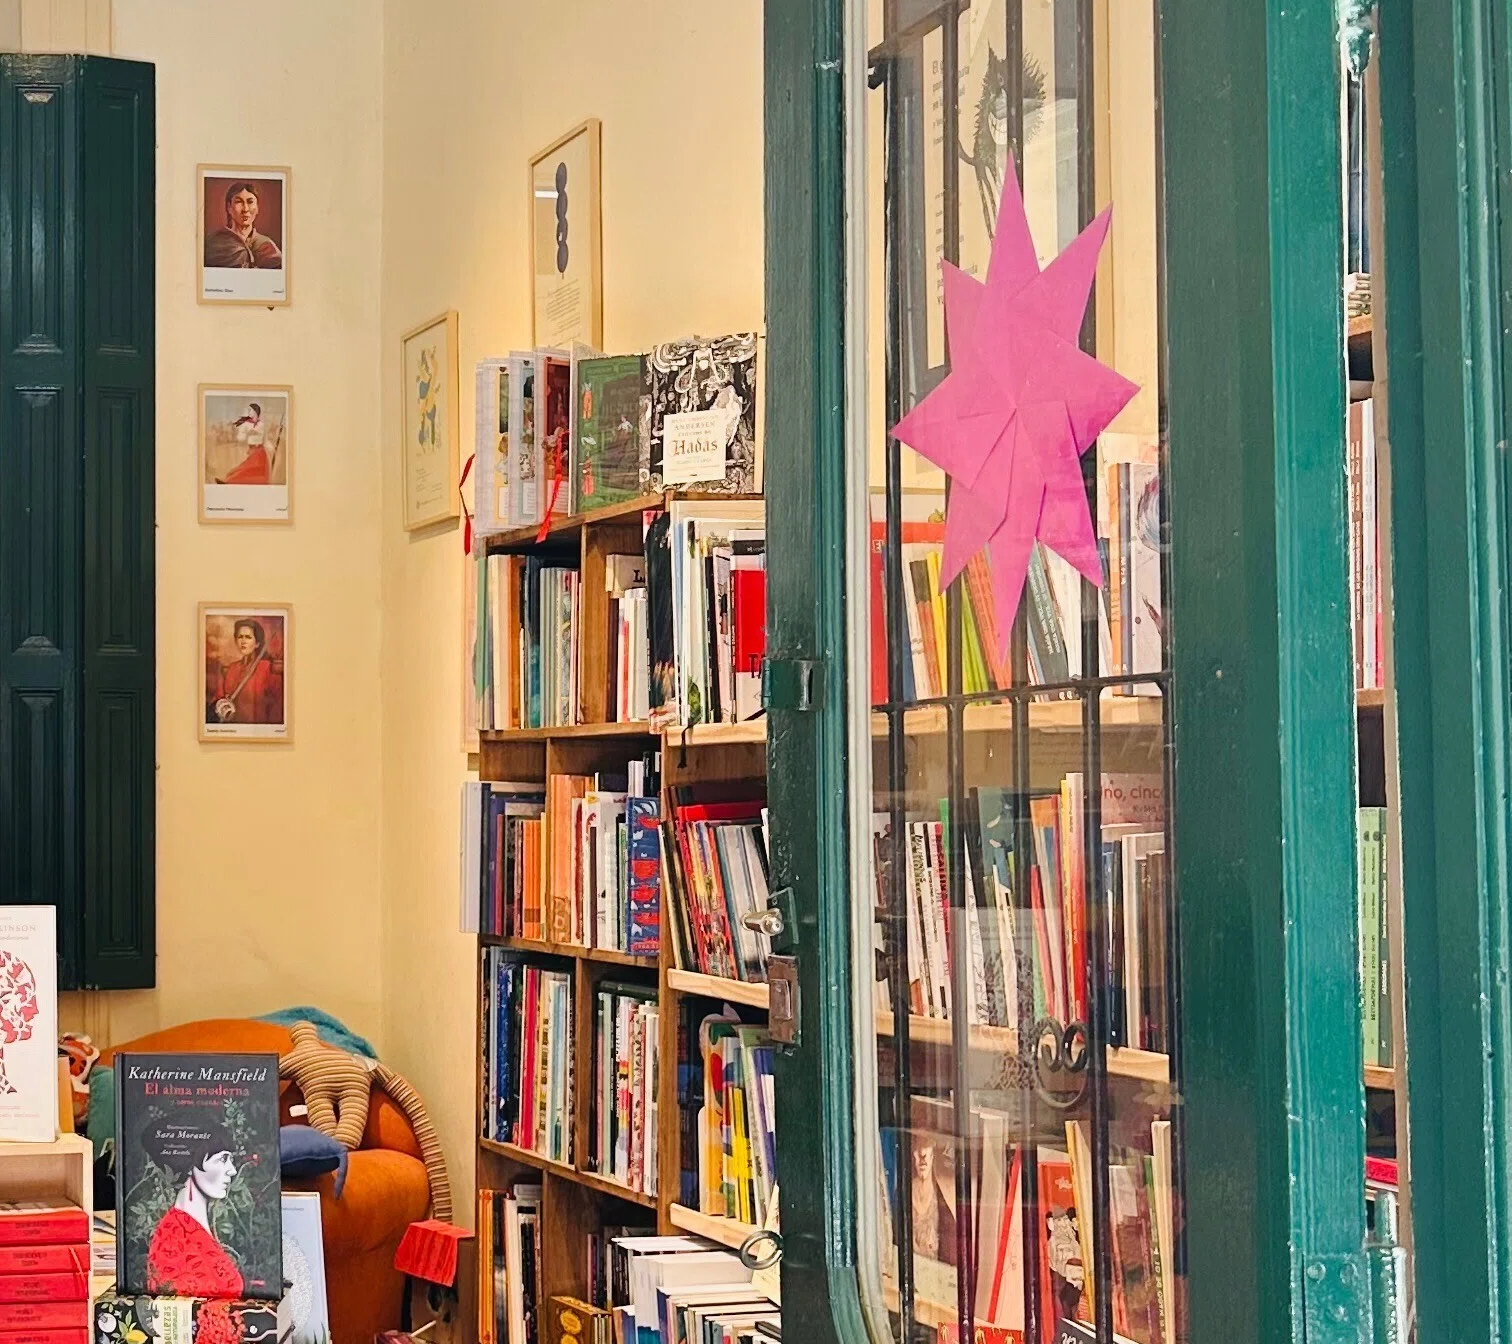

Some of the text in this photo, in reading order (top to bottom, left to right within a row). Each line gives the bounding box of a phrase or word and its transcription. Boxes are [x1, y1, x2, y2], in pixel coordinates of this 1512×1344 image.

[672, 438, 718, 457] Hadas
[1130, 783, 1163, 799] cinc
[128, 1066, 267, 1084] Katherine Mansfield
[144, 1082, 250, 1097] El alma moderna
